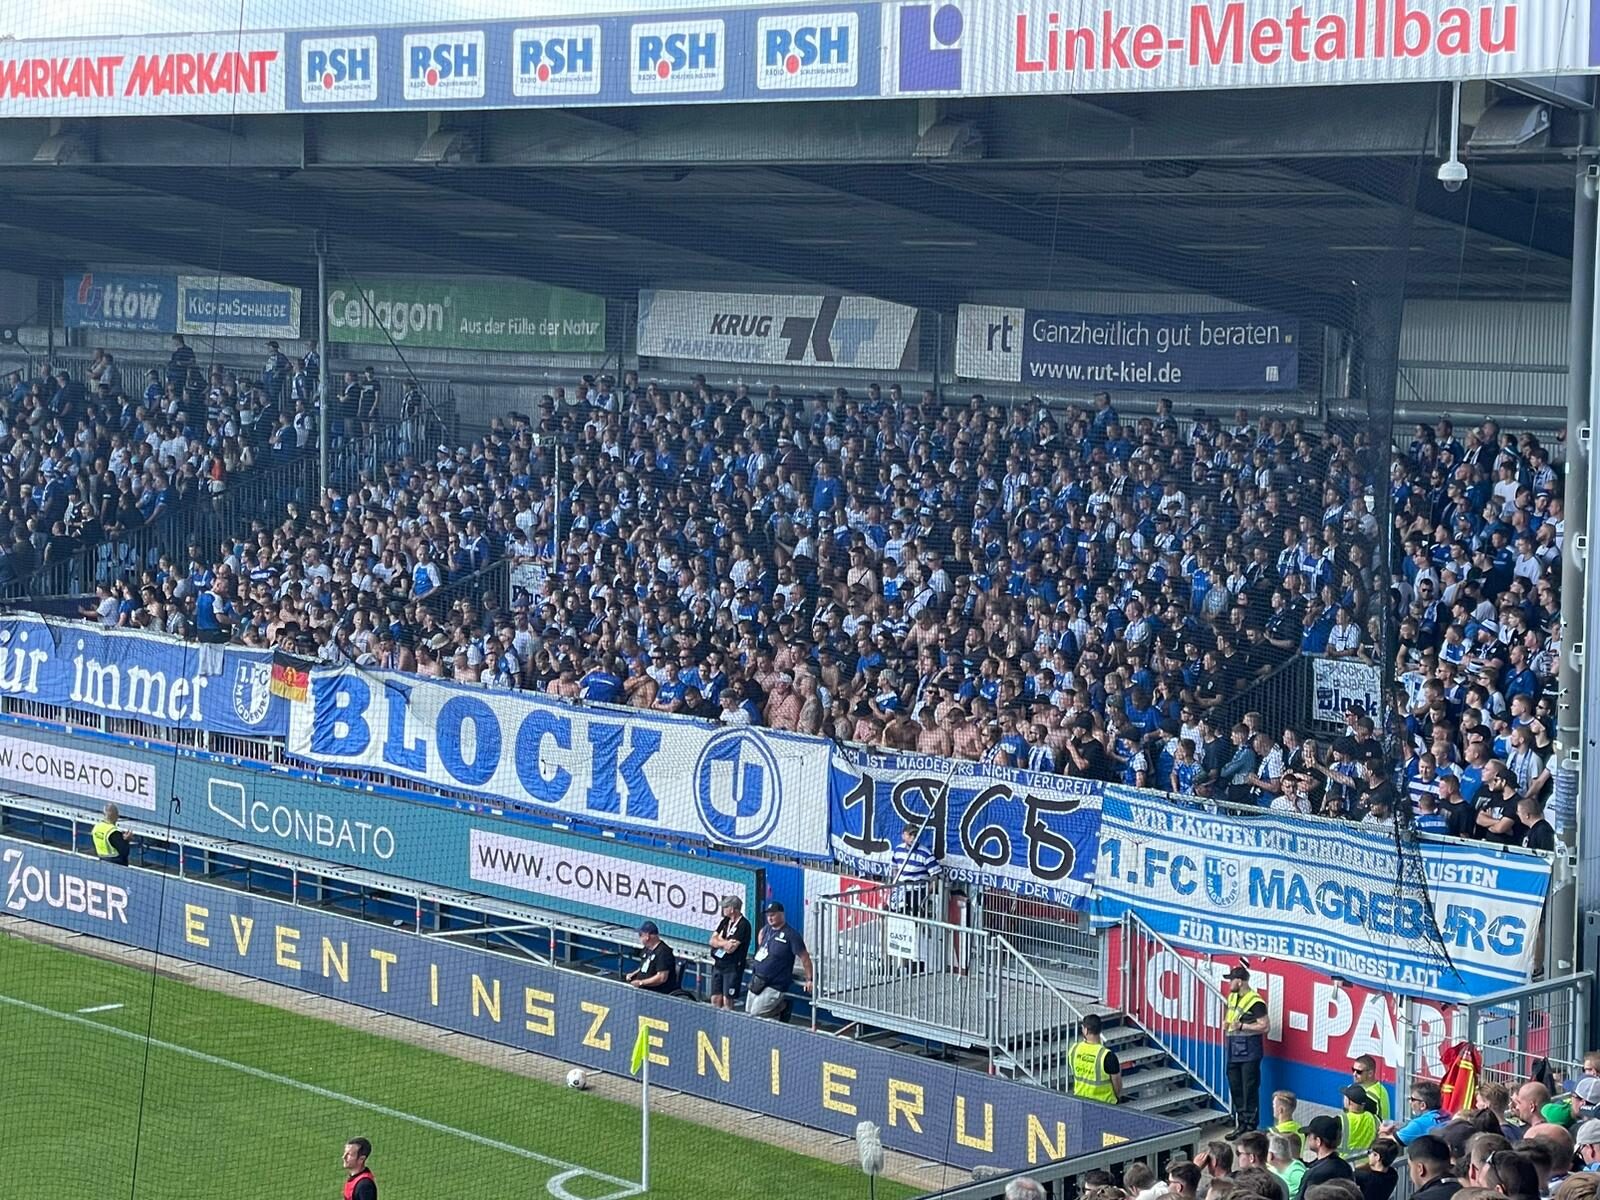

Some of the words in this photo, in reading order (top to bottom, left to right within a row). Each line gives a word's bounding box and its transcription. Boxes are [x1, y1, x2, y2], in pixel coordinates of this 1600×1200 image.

[1015, 0, 1518, 73] Linke-Metallbau
[124, 50, 278, 97] MARKANT
[460, 317, 481, 334] Aus
[484, 317, 505, 334] der
[508, 317, 535, 335] Fülle
[539, 319, 559, 336] der
[563, 319, 600, 336] Natur
[710, 313, 773, 338] KRUG
[1033, 319, 1149, 346] Ganzheitlich
[1157, 323, 1191, 353] gut
[1030, 361, 1181, 383] www.rut-kiel.de
[69, 638, 208, 721] immer
[311, 672, 662, 820] BLOCK
[866, 753, 887, 769] IST
[896, 756, 975, 776] MAGDEBURG
[982, 764, 1019, 782] NICHT
[1026, 772, 1092, 795] VERLOREN
[251, 800, 395, 860] CONBATO
[842, 772, 1081, 880] 1965
[1132, 808, 1168, 832] WIR
[1172, 813, 1256, 847] KÄMPFEN
[1260, 829, 1297, 854] MIT
[3, 849, 128, 924] ZOUBER
[478, 844, 727, 918] WWW.CONBATO.D
[858, 858, 883, 875] SIND
[1002, 877, 1021, 893] AUF
[1025, 881, 1049, 900] DER
[1054, 888, 1077, 907] WELT
[1101, 838, 1198, 896] 1.FC
[1248, 866, 1525, 958] MAGDEBURG
[1178, 919, 1213, 942] FÜR
[1218, 924, 1289, 954] UNSERE
[1293, 938, 1443, 989] FESTUNGSSTADT
[185, 903, 1130, 1164] EVENTINSZENIERUN
